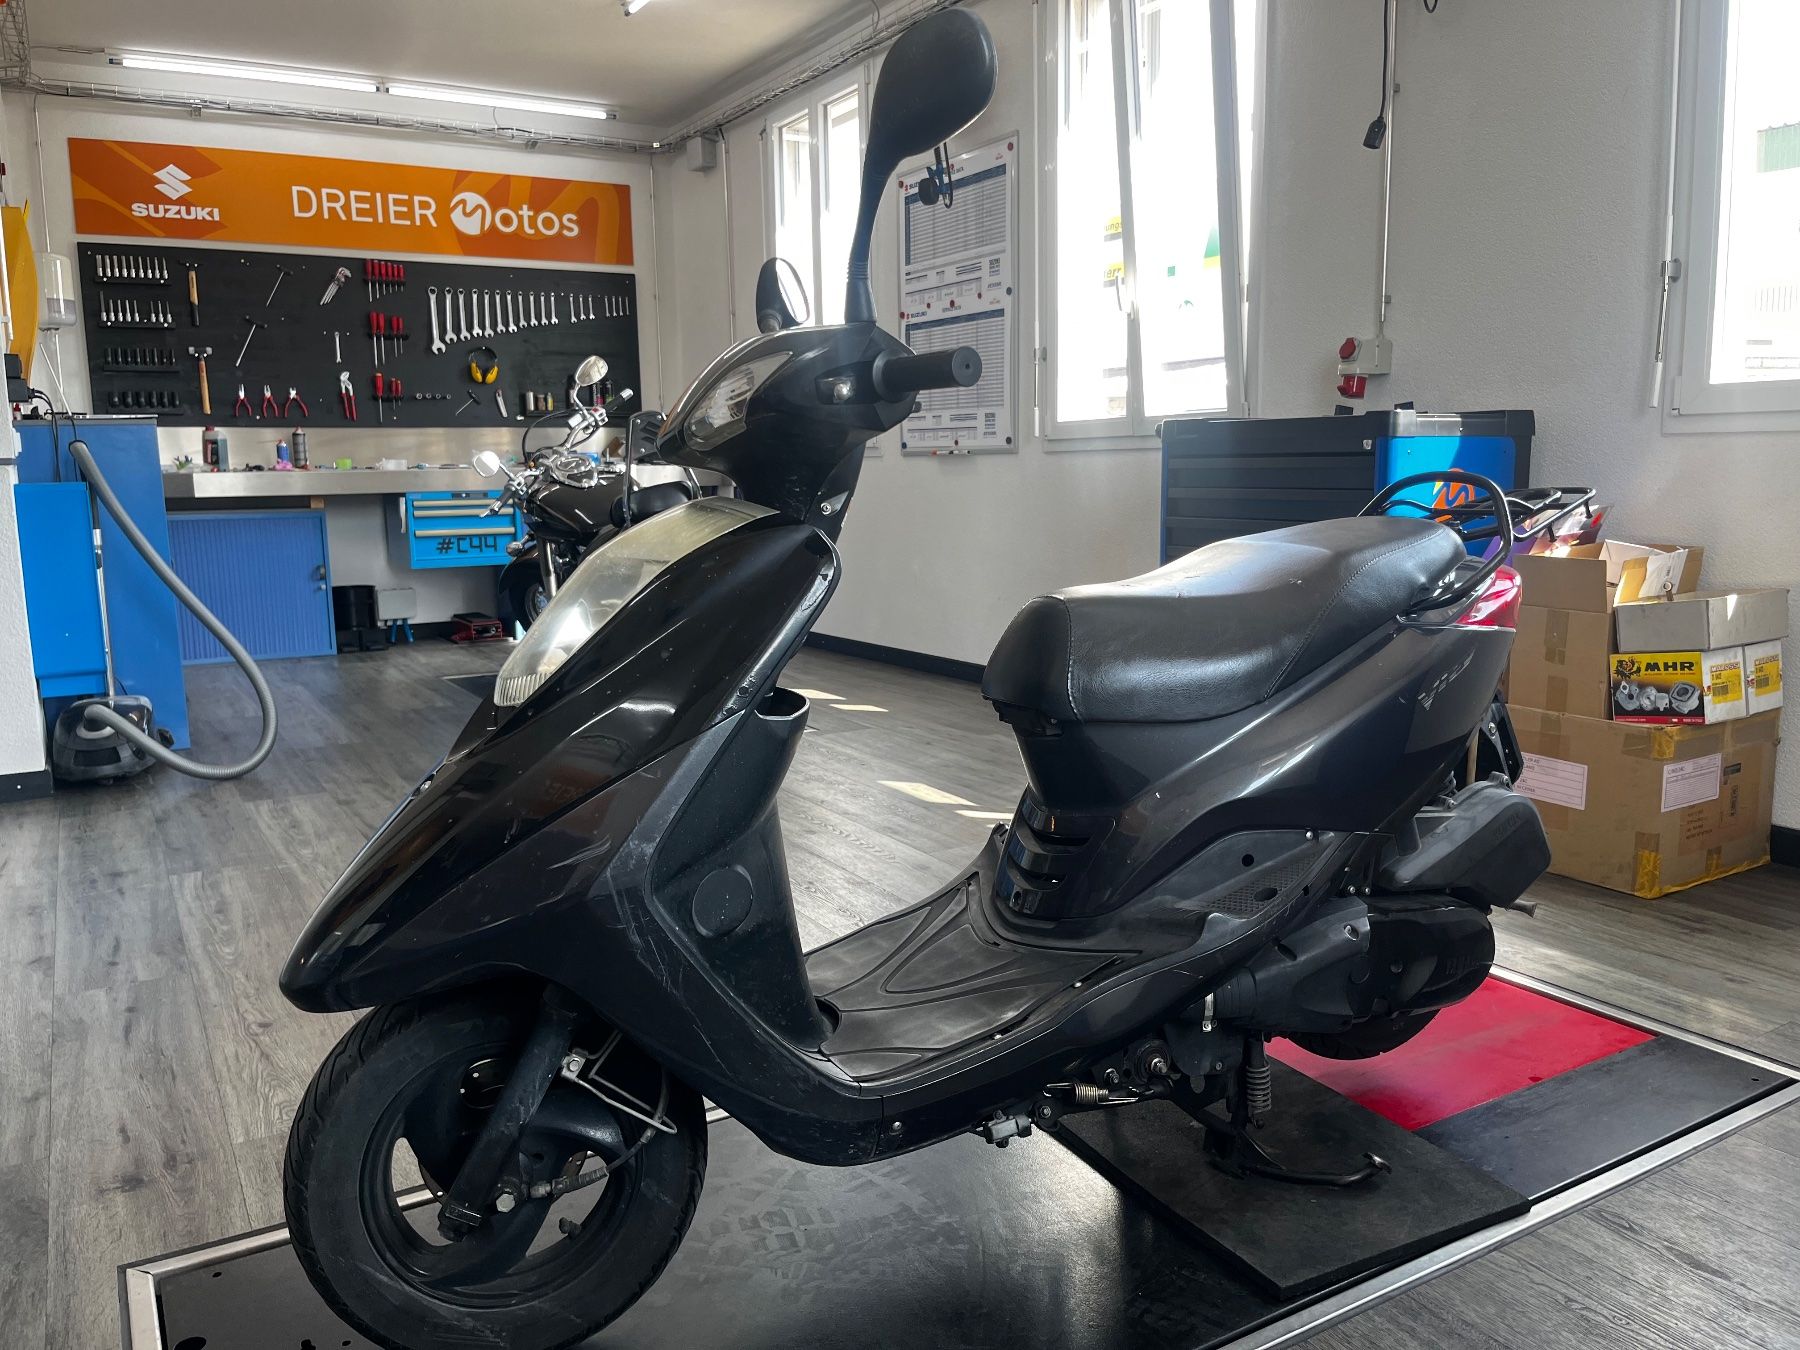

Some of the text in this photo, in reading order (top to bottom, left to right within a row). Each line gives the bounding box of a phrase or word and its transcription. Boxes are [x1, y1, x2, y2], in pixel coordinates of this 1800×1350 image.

[131, 202, 220, 222] SUZUKI
[291, 185, 580, 239] DREIER Motos
[436, 535, 498, 554] #C44
[1644, 661, 1694, 672] MHR
